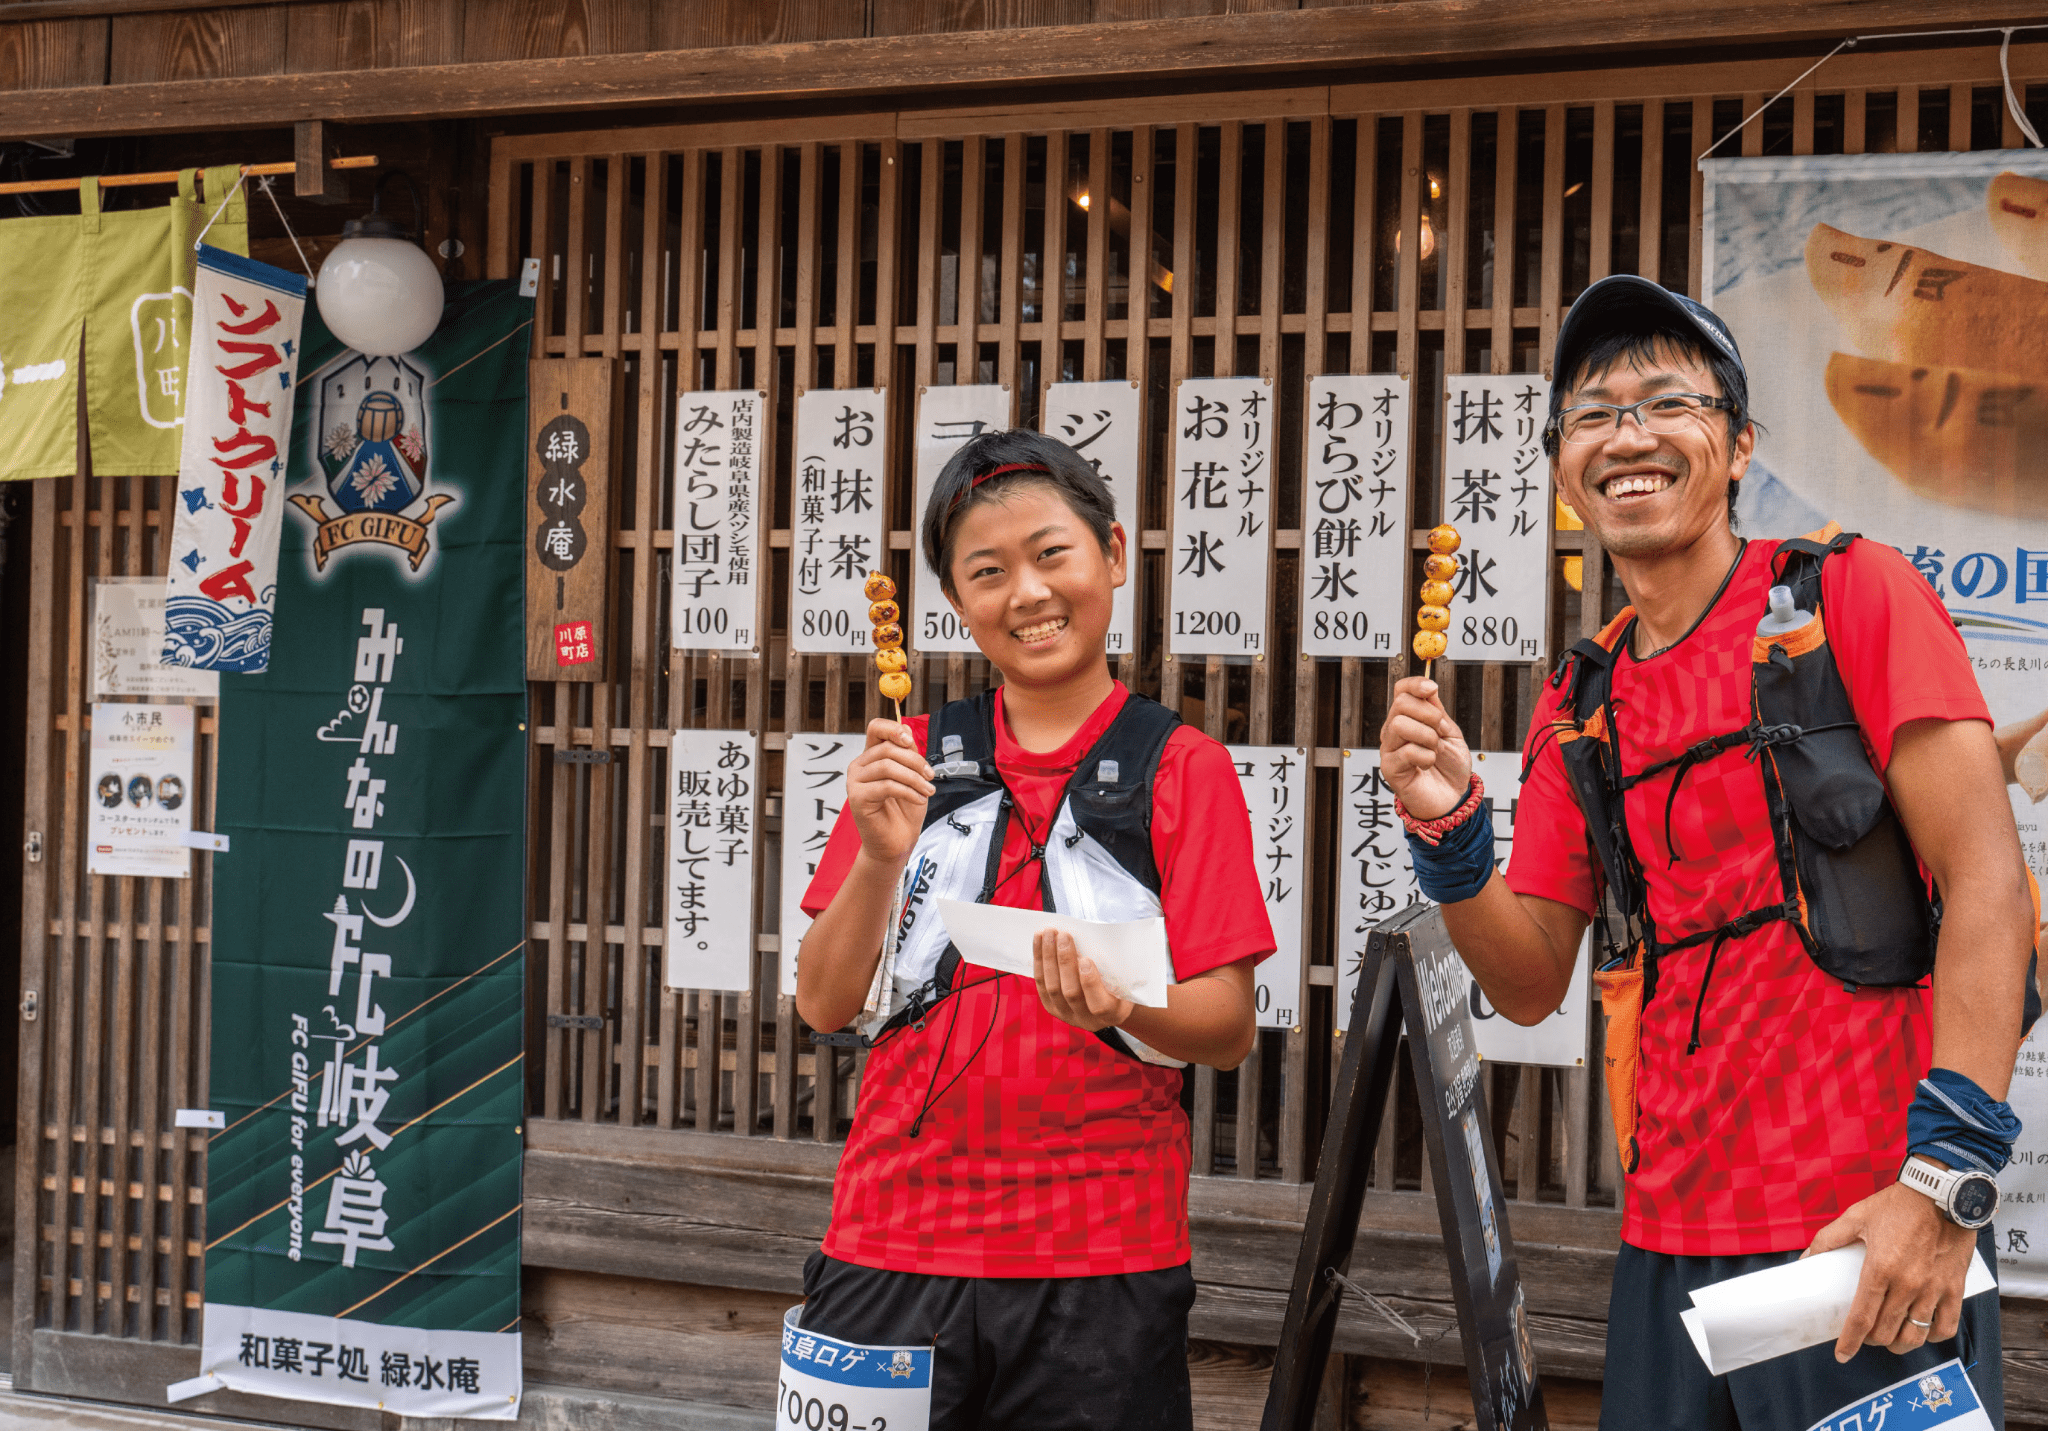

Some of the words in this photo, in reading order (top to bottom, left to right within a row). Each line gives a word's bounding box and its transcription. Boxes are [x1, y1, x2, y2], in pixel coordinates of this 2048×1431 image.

[198, 292, 283, 604] ソフトクリーム
[545, 430, 580, 561] 緑水庵
[678, 404, 725, 599] みたらし団子
[726, 398, 755, 586] 店内製造岐阜県産ハツシモ使用
[828, 405, 875, 581] お抹茶
[1178, 395, 1230, 578] お花氷
[1236, 390, 1267, 538] オリジナル
[1310, 391, 1364, 602] わらび餅氷
[1367, 387, 1400, 538] オリジナル
[1450, 389, 1505, 604] 抹茶氷
[1508, 384, 1542, 538] オリジナル
[326, 518, 355, 547] FC
[360, 515, 419, 546] GIFU
[1106, 632, 1123, 649] 円
[123, 711, 162, 726] 小市民
[675, 769, 713, 951] 販売してます。
[714, 740, 750, 867] あゆ菓子
[802, 741, 845, 876] ソフトク
[1265, 754, 1296, 903] オリジナル
[290, 1012, 309, 1049] FC
[290, 1051, 309, 1113] GIFU
[290, 1115, 308, 1151] for
[2001, 1192, 2046, 1204] 流長良川
[287, 1153, 304, 1263] everyone
[238, 1332, 370, 1383] 和菓子処
[381, 1350, 481, 1395] 緑水庵
